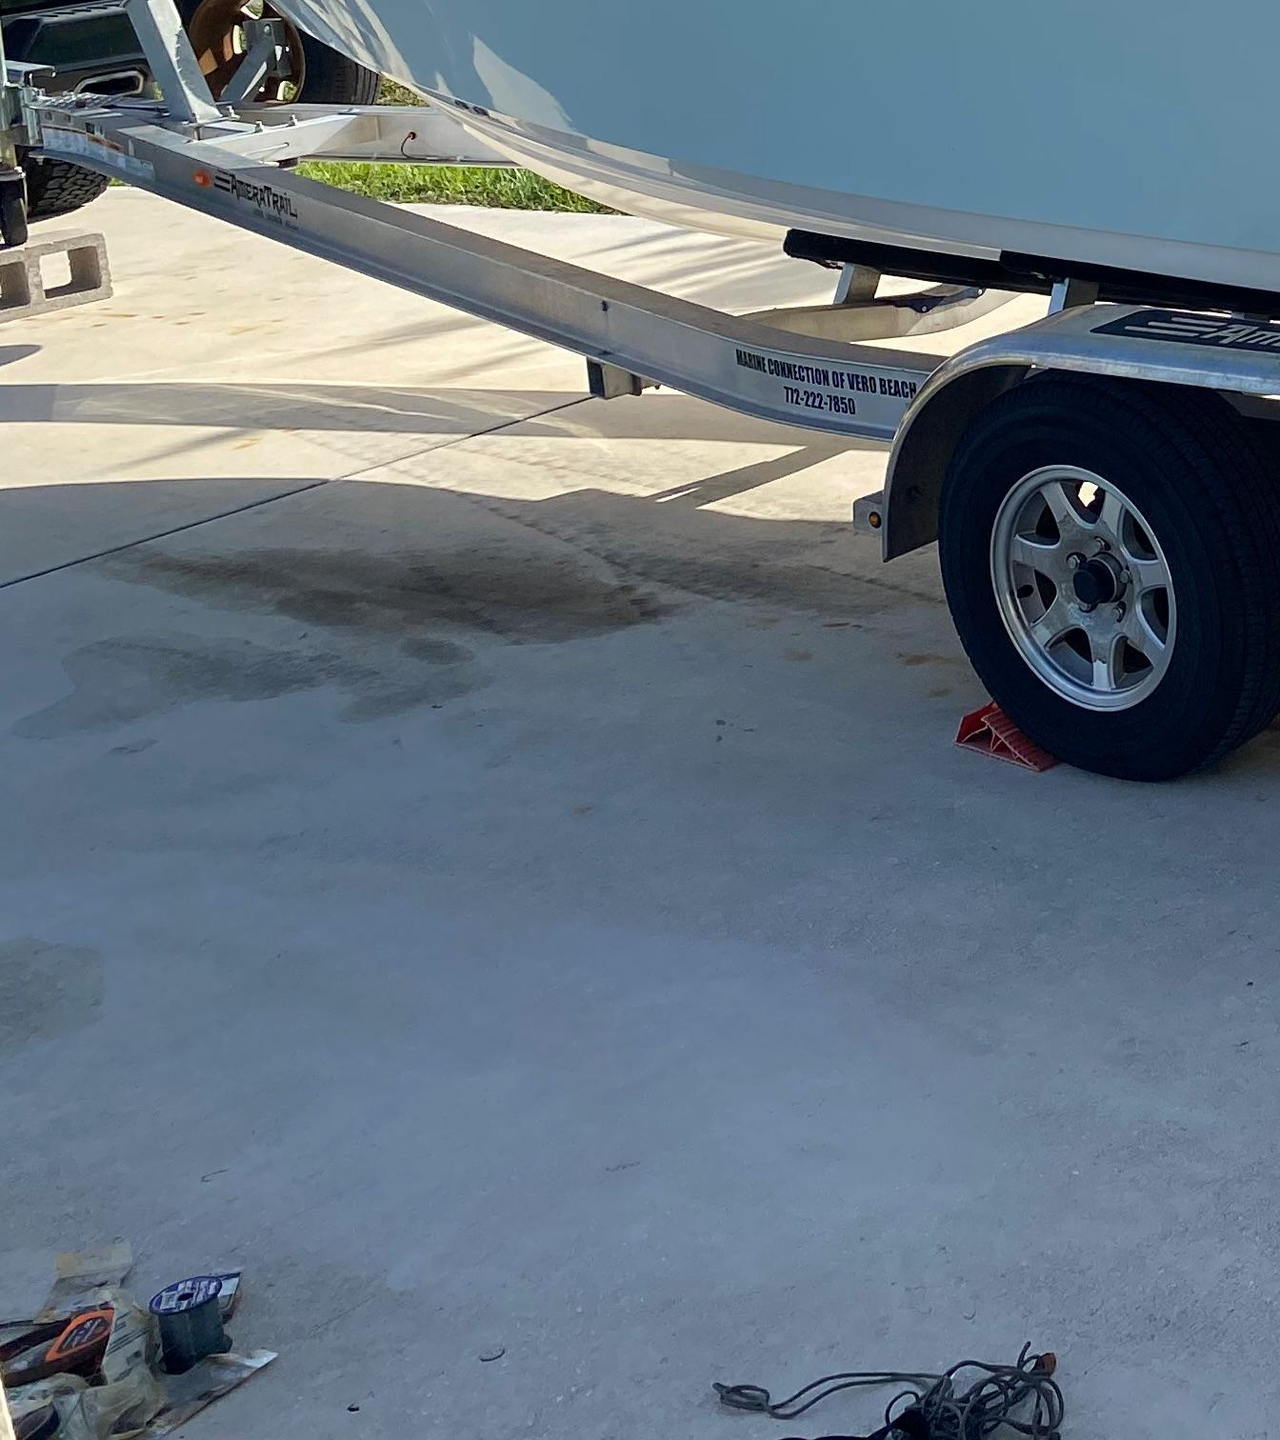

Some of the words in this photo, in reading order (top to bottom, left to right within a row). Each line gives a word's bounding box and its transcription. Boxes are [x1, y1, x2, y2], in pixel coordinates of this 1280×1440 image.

[735, 348, 768, 374] MARINE
[767, 358, 831, 387] CONNECTION
[831, 371, 846, 390] OF
[846, 372, 878, 394] VERO
[878, 378, 917, 399] BEACH
[783, 386, 857, 415] 772-222-7850
